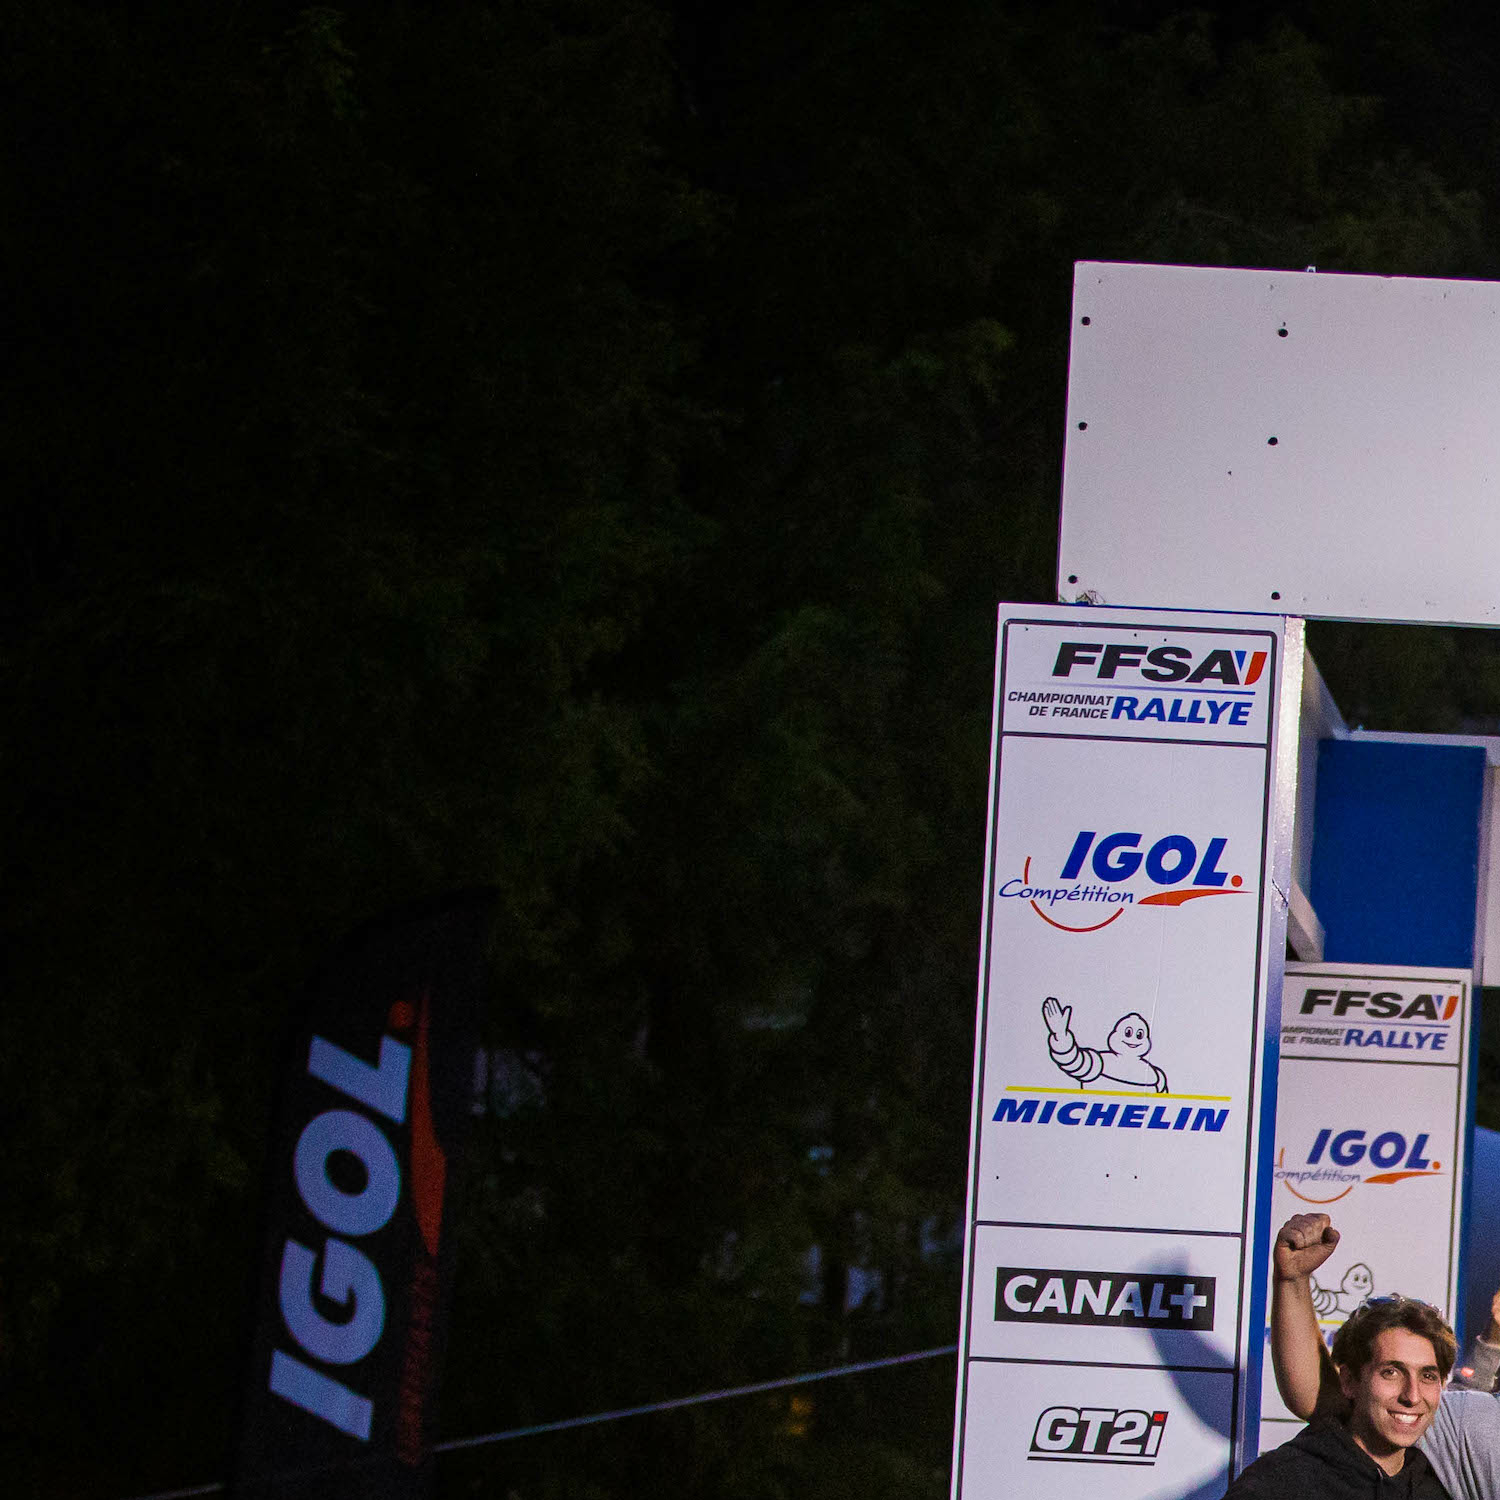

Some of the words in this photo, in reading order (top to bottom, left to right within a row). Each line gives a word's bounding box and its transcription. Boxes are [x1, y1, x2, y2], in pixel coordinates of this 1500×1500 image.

[1052, 642, 1240, 686] FFSA
[1008, 690, 1114, 708] CHAMPIONNAT
[1029, 705, 1050, 718] DE
[1051, 706, 1110, 720] FRANCE
[1111, 695, 1251, 727] RALLYE
[999, 878, 1135, 907] Compétition
[1300, 988, 1441, 1021] FFSA
[1282, 1036, 1297, 1045] DE
[1299, 1036, 1344, 1048] FRANCE
[1344, 1028, 1449, 1051] RALLYE
[991, 1098, 1231, 1133] MICHELIN
[1274, 1163, 1362, 1185] ompétition
[1002, 1273, 1208, 1322] CANAL+
